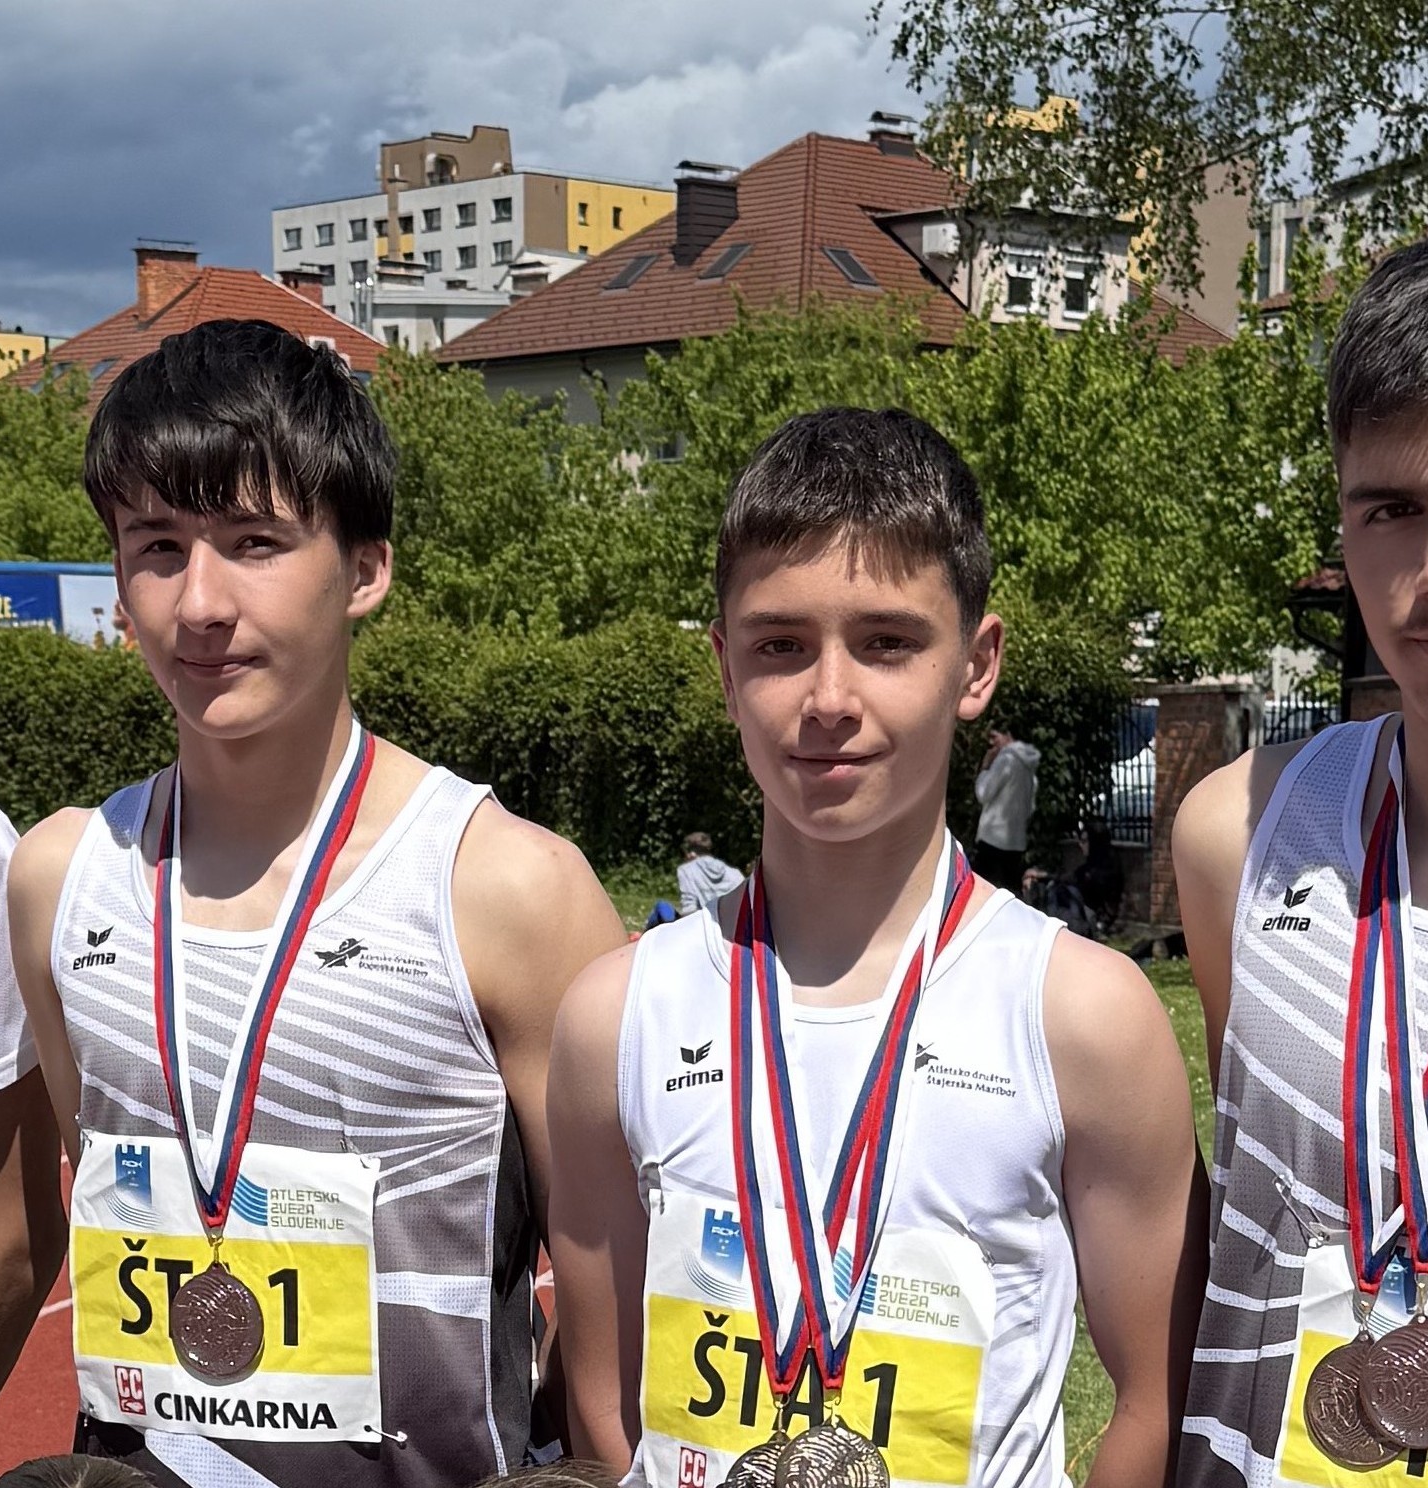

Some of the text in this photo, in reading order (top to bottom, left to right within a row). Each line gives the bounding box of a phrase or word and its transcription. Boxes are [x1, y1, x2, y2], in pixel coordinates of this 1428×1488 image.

[1262, 912, 1311, 931] erima
[73, 950, 116, 970] erima
[665, 1067, 724, 1092] erima
[928, 1065, 970, 1077] Atletsko
[975, 1083, 1016, 1097] Maribor
[269, 1188, 339, 1204] ATLETSKA
[269, 1202, 315, 1216] ZVEZA
[270, 1215, 345, 1231] SLOVENIJE
[119, 1238, 299, 1347] ŠT 1
[880, 1275, 961, 1299] ATLETSKA
[878, 1290, 929, 1309] ZVEZA
[877, 1305, 960, 1328] SLOVENIJE
[154, 1391, 337, 1430] CINKARNA
[864, 1363, 898, 1448] 1
